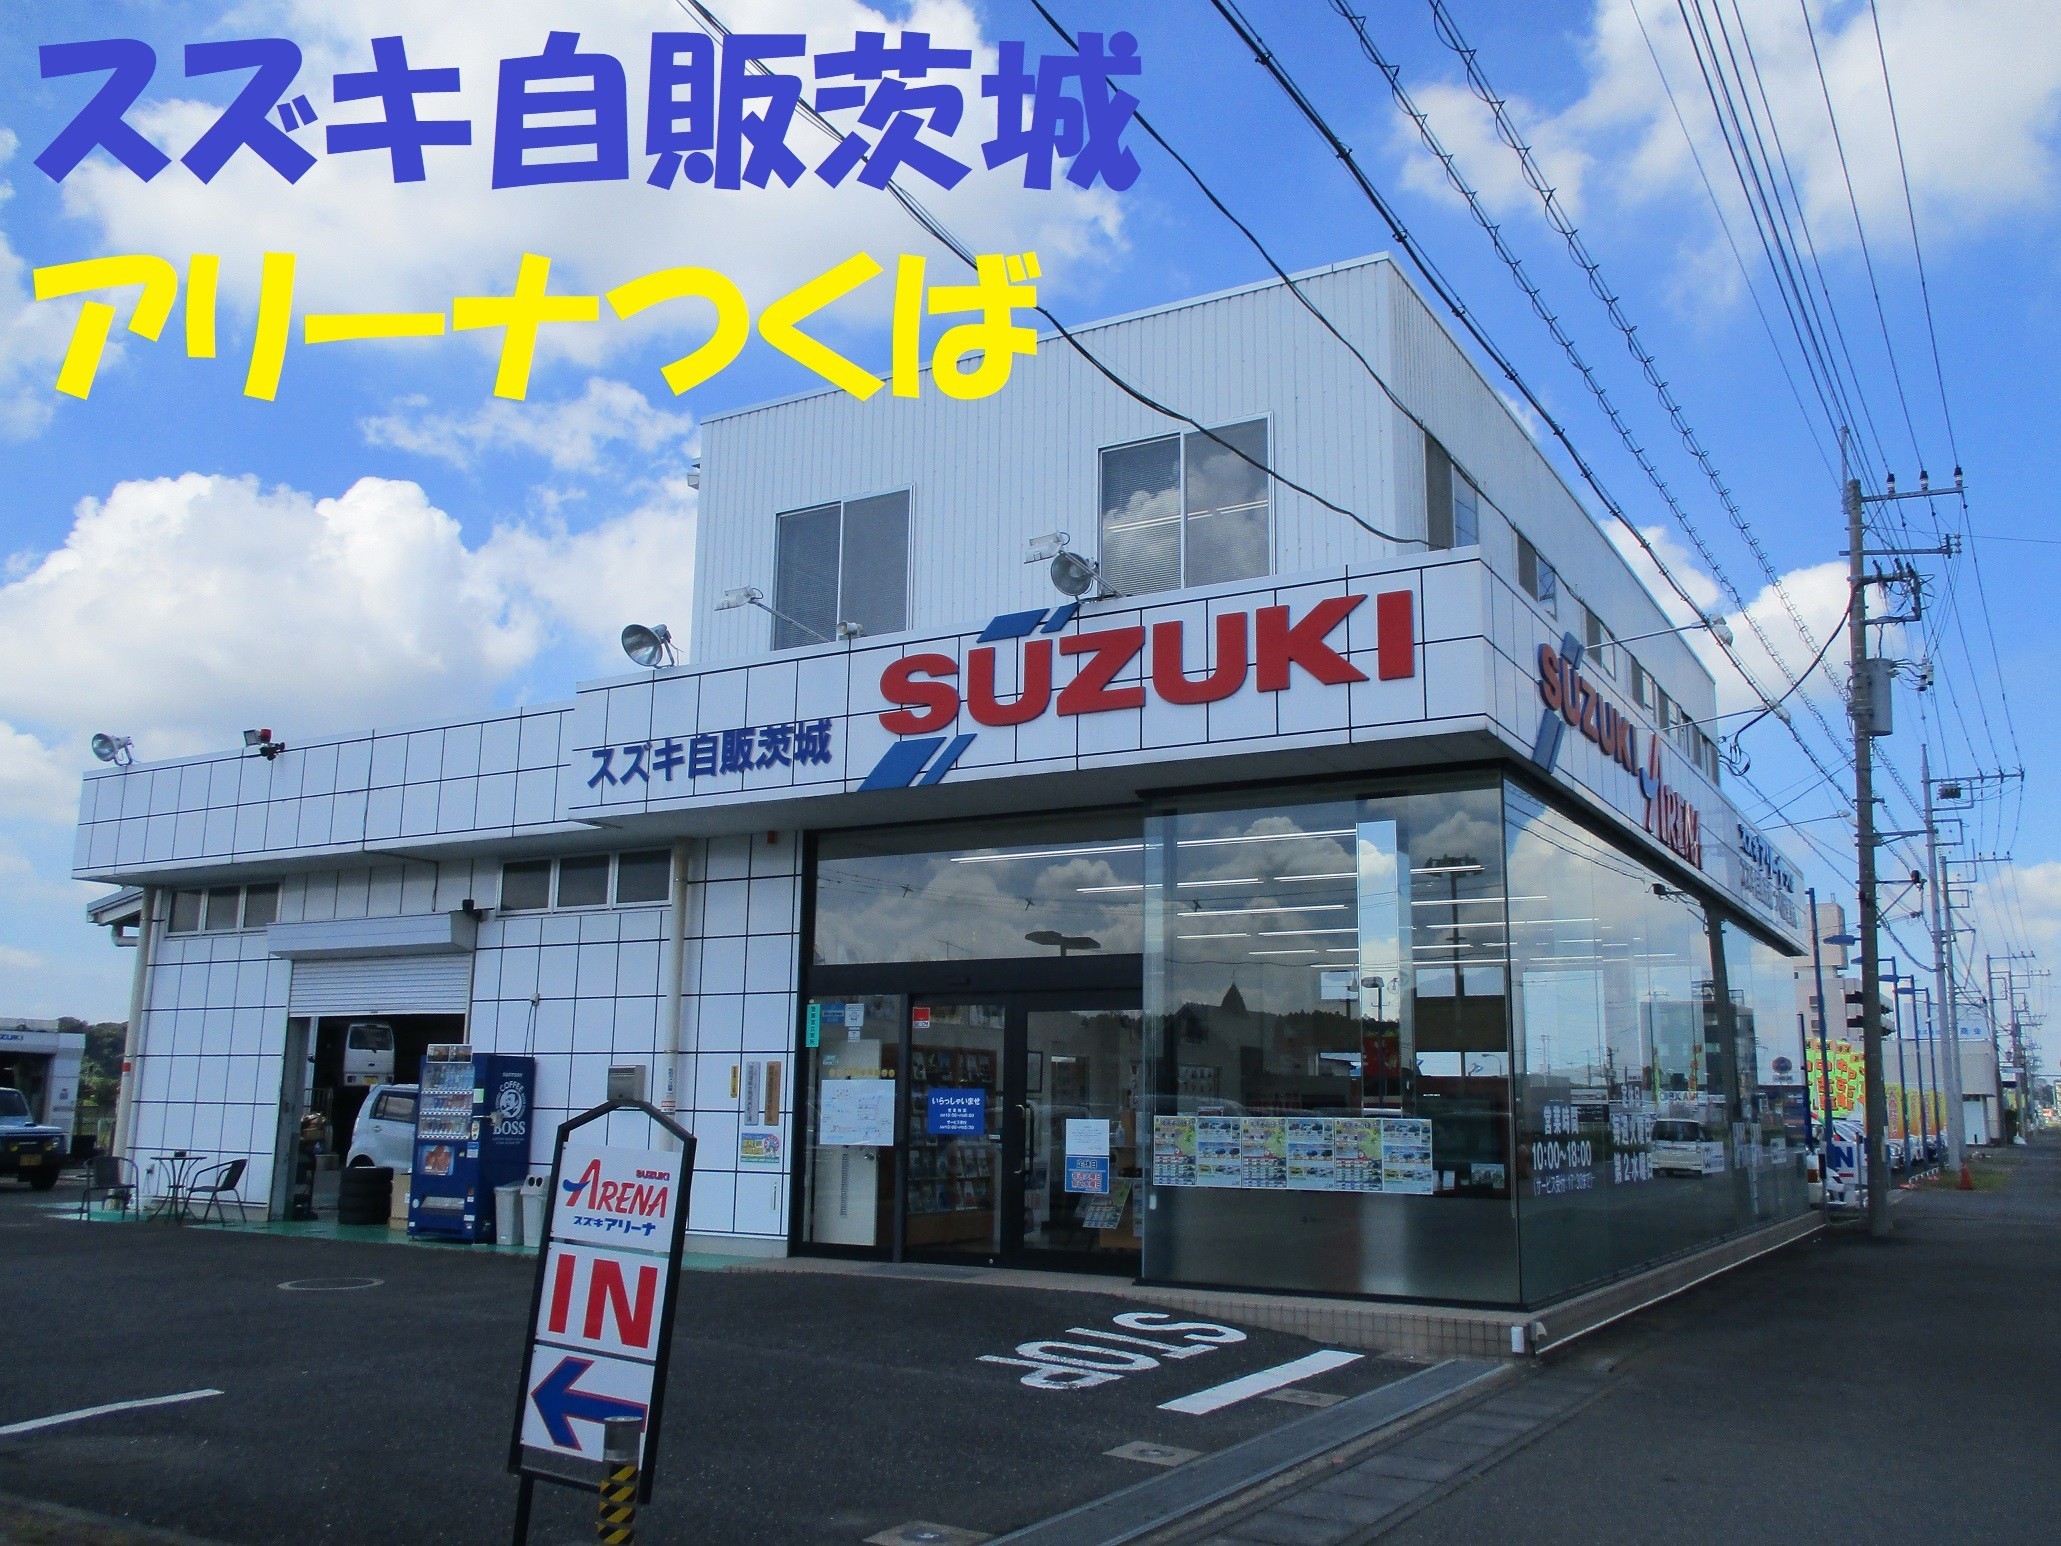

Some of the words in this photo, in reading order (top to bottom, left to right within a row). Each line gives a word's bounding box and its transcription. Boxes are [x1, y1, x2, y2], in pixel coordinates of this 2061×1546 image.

[879, 590, 1414, 735] SUZUKI
[1538, 642, 1640, 777] SUZUKI
[587, 718, 833, 789] スズキ自販茨城
[500, 1081, 524, 1093] COFFEE
[931, 1096, 981, 1106] いらっしゃいませ
[563, 1158, 668, 1218] ARENA
[636, 1169, 670, 1181] SUZUKI
[573, 1216, 656, 1236] スズキアリーナ
[548, 1253, 659, 1349] IN
[975, 1312, 1248, 1390] STOP
